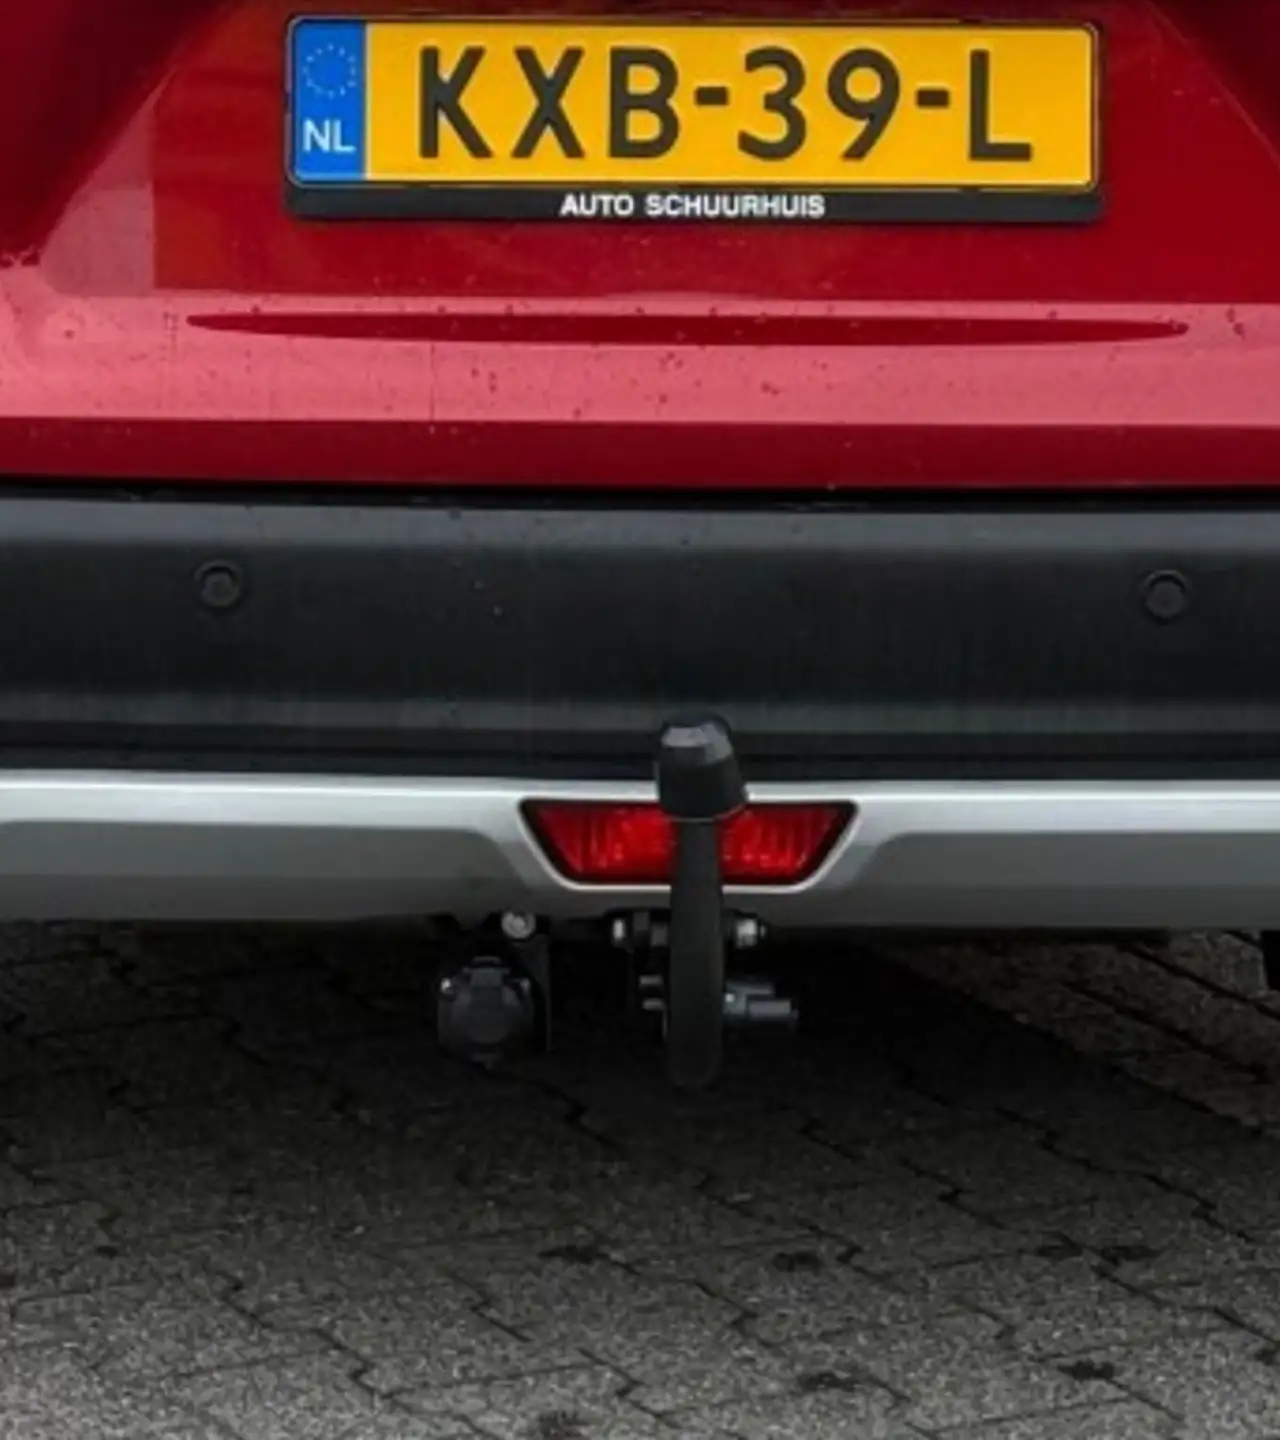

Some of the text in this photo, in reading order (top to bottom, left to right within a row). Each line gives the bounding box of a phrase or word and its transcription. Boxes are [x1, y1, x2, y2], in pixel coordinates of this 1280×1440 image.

[417, 45, 1034, 162] KXB-39-L
[302, 119, 356, 154] NL
[558, 192, 826, 219] AUTO SCHUURHUIS
